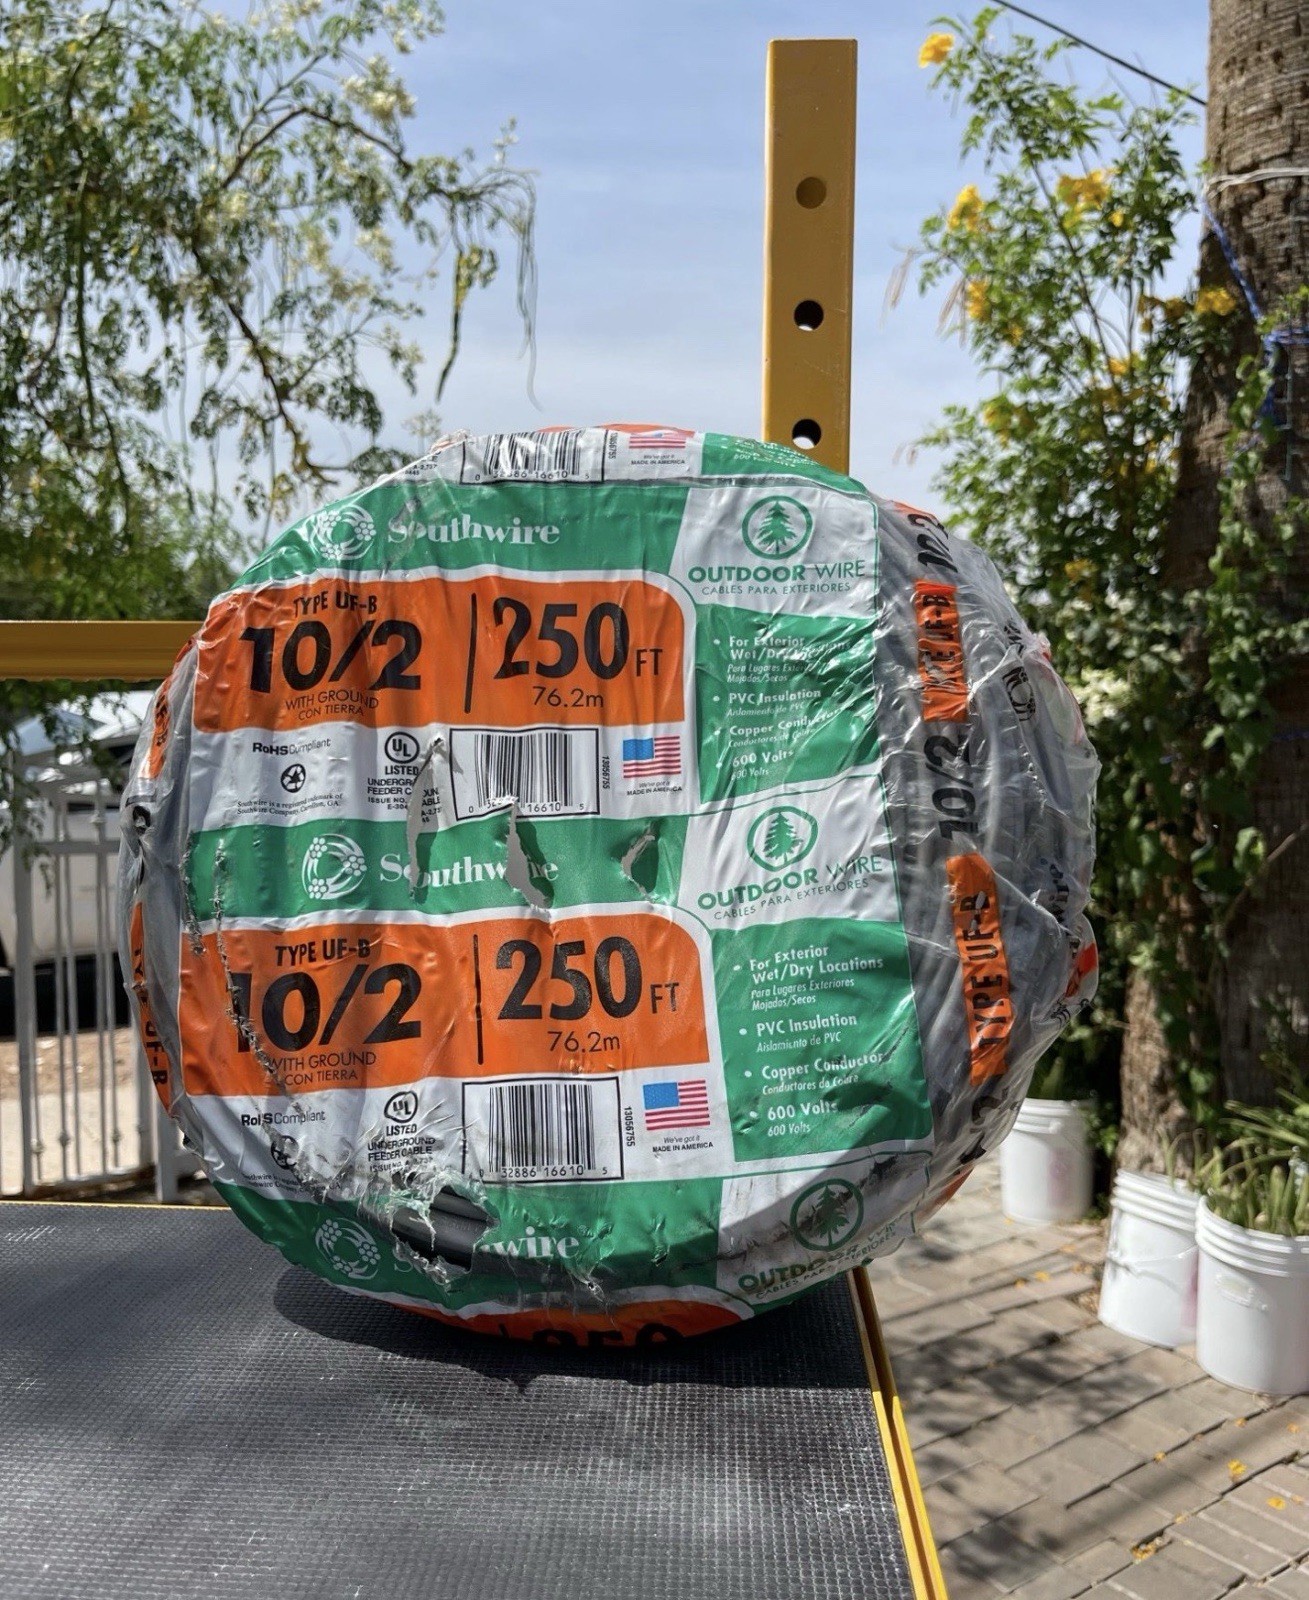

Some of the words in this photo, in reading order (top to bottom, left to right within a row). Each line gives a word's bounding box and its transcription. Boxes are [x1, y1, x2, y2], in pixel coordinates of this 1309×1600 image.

[534, 469, 568, 479] 16610
[388, 513, 560, 545] Southwire
[688, 564, 806, 583] OUTDOOR
[814, 560, 866, 580] WIRE
[701, 585, 743, 596] CABLES
[748, 585, 777, 595] PARA
[783, 582, 850, 595] EXTERIORES
[294, 590, 328, 618] TYPE
[336, 590, 378, 613] UF-B
[239, 619, 423, 693] 10/2
[493, 596, 630, 680] 250
[636, 649, 663, 677] FT
[729, 636, 749, 647] For
[754, 635, 806, 647] Exterior
[727, 664, 747, 673] Para
[748, 663, 781, 674] Lugares
[285, 694, 315, 711] WITH
[318, 689, 379, 710] GROUND
[533, 685, 604, 708] 76.2m
[729, 692, 755, 705] PVC
[758, 688, 822, 705] Insulation
[789, 701, 806, 711] PVC
[298, 706, 319, 721] CON
[325, 703, 364, 718] TIERRA
[729, 725, 774, 738] Copper
[392, 738, 412, 758] UL
[729, 736, 777, 749] Conductores
[732, 752, 758, 768] 600
[761, 749, 794, 764] Volts
[385, 765, 419, 776] LISTED
[732, 769, 747, 781] 600
[750, 767, 769, 777] Volts
[367, 786, 403, 795] FEEDER
[627, 788, 645, 796] MADE
[923, 735, 979, 841] 10/2
[368, 796, 391, 804] ISSUE
[468, 806, 474, 814] 0
[527, 802, 561, 813] 16610
[579, 803, 585, 811] 5
[698, 867, 819, 910] OUTDOOR
[826, 854, 883, 880] WIRE
[714, 904, 757, 920] CABLES
[761, 893, 792, 909] PARA
[797, 877, 869, 900] EXTERIORES
[960, 891, 1001, 962] UF-B
[275, 942, 317, 967] TYPE
[322, 938, 371, 960] UF-B
[750, 959, 770, 972] For
[774, 944, 829, 964] Exterior
[753, 962, 814, 985] Wet/Dry
[819, 956, 884, 974] Locations
[226, 963, 422, 1053] 10/2
[496, 936, 643, 1021] 250
[650, 982, 680, 1014] FT
[751, 988, 771, 1000] Para
[773, 983, 807, 997] Lugares
[809, 978, 855, 991] Exteriores
[752, 994, 816, 1012] Mojados/Secos
[970, 973, 1006, 1049] TYPE
[756, 1020, 786, 1037] PVC
[789, 1014, 858, 1033] Insulation
[547, 1030, 621, 1053] 76.2m
[757, 1039, 807, 1053] Aislamiento
[810, 1034, 821, 1046] de
[824, 1031, 842, 1044] PVC
[272, 1055, 305, 1072] WITH
[308, 1052, 377, 1069] GROUND
[762, 1063, 810, 1081] Copper
[814, 1052, 884, 1072] Conductor
[285, 1072, 314, 1086] CON
[317, 1070, 358, 1083] TIERRA
[762, 1081, 817, 1096] Conductores
[767, 1105, 796, 1121] 600
[800, 1100, 838, 1116] Volts
[386, 1123, 417, 1136] LISTED
[623, 1106, 636, 1147] 13056755
[767, 1125, 786, 1137] 600
[788, 1122, 811, 1135] Volts
[367, 1136, 436, 1151] UNDERGROUND
[652, 1144, 672, 1153] MADE
[682, 1142, 714, 1151] AMERICA
[663, 1135, 682, 1144] We've
[682, 1135, 694, 1145] got
[695, 1134, 700, 1143] it
[368, 1150, 401, 1162] FEEDER
[401, 1145, 433, 1157] CABLE
[501, 1166, 537, 1178] 32886
[544, 1164, 585, 1177] 16610
[602, 1166, 608, 1175] 5
[755, 1279, 799, 1299] CABLES
